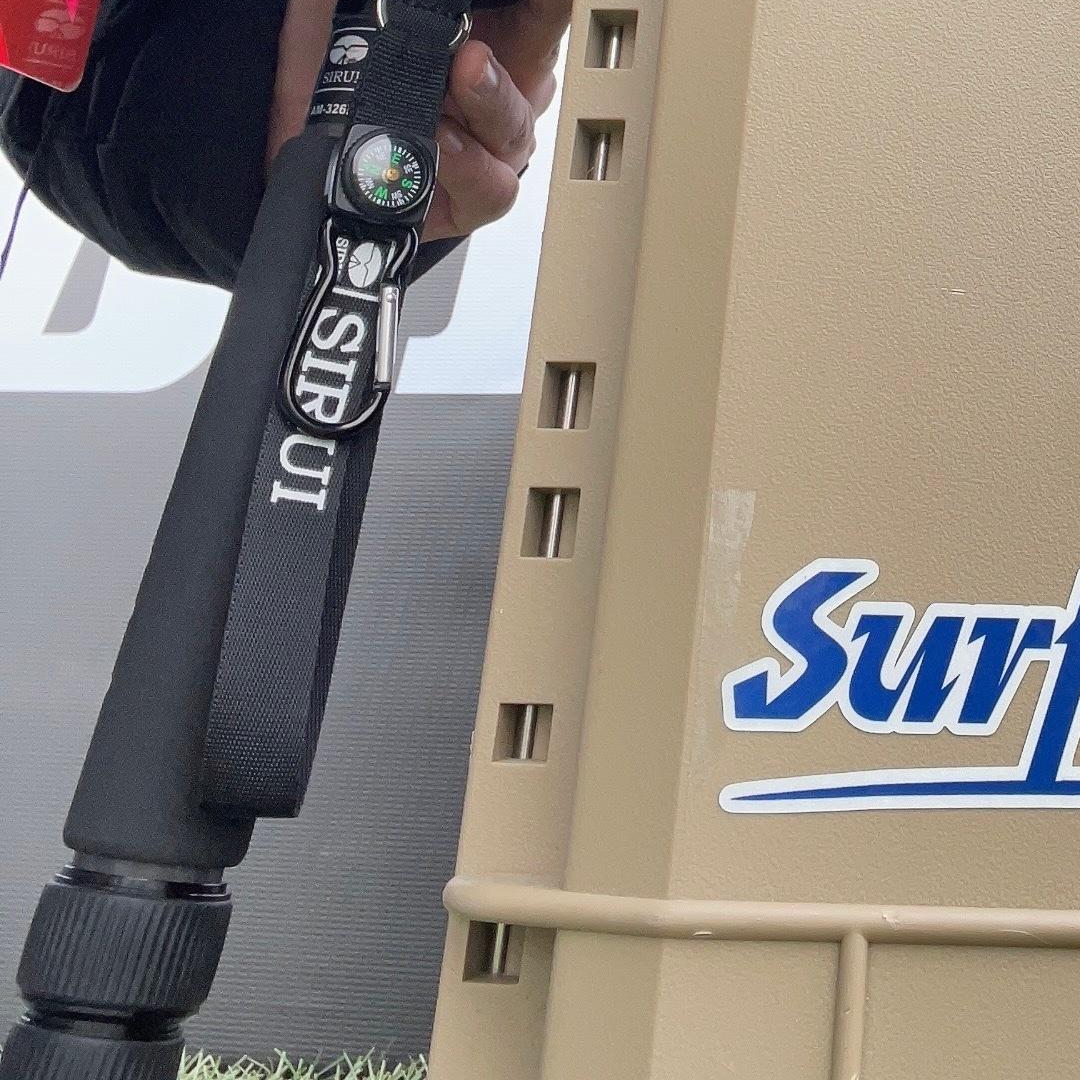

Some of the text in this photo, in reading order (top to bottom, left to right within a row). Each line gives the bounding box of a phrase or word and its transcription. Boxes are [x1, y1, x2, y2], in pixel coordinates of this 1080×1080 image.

[309, 102, 350, 116] AM-326
[391, 151, 402, 165] E
[401, 178, 413, 189] S
[373, 185, 389, 200] W
[270, 307, 368, 511] SIRUI
